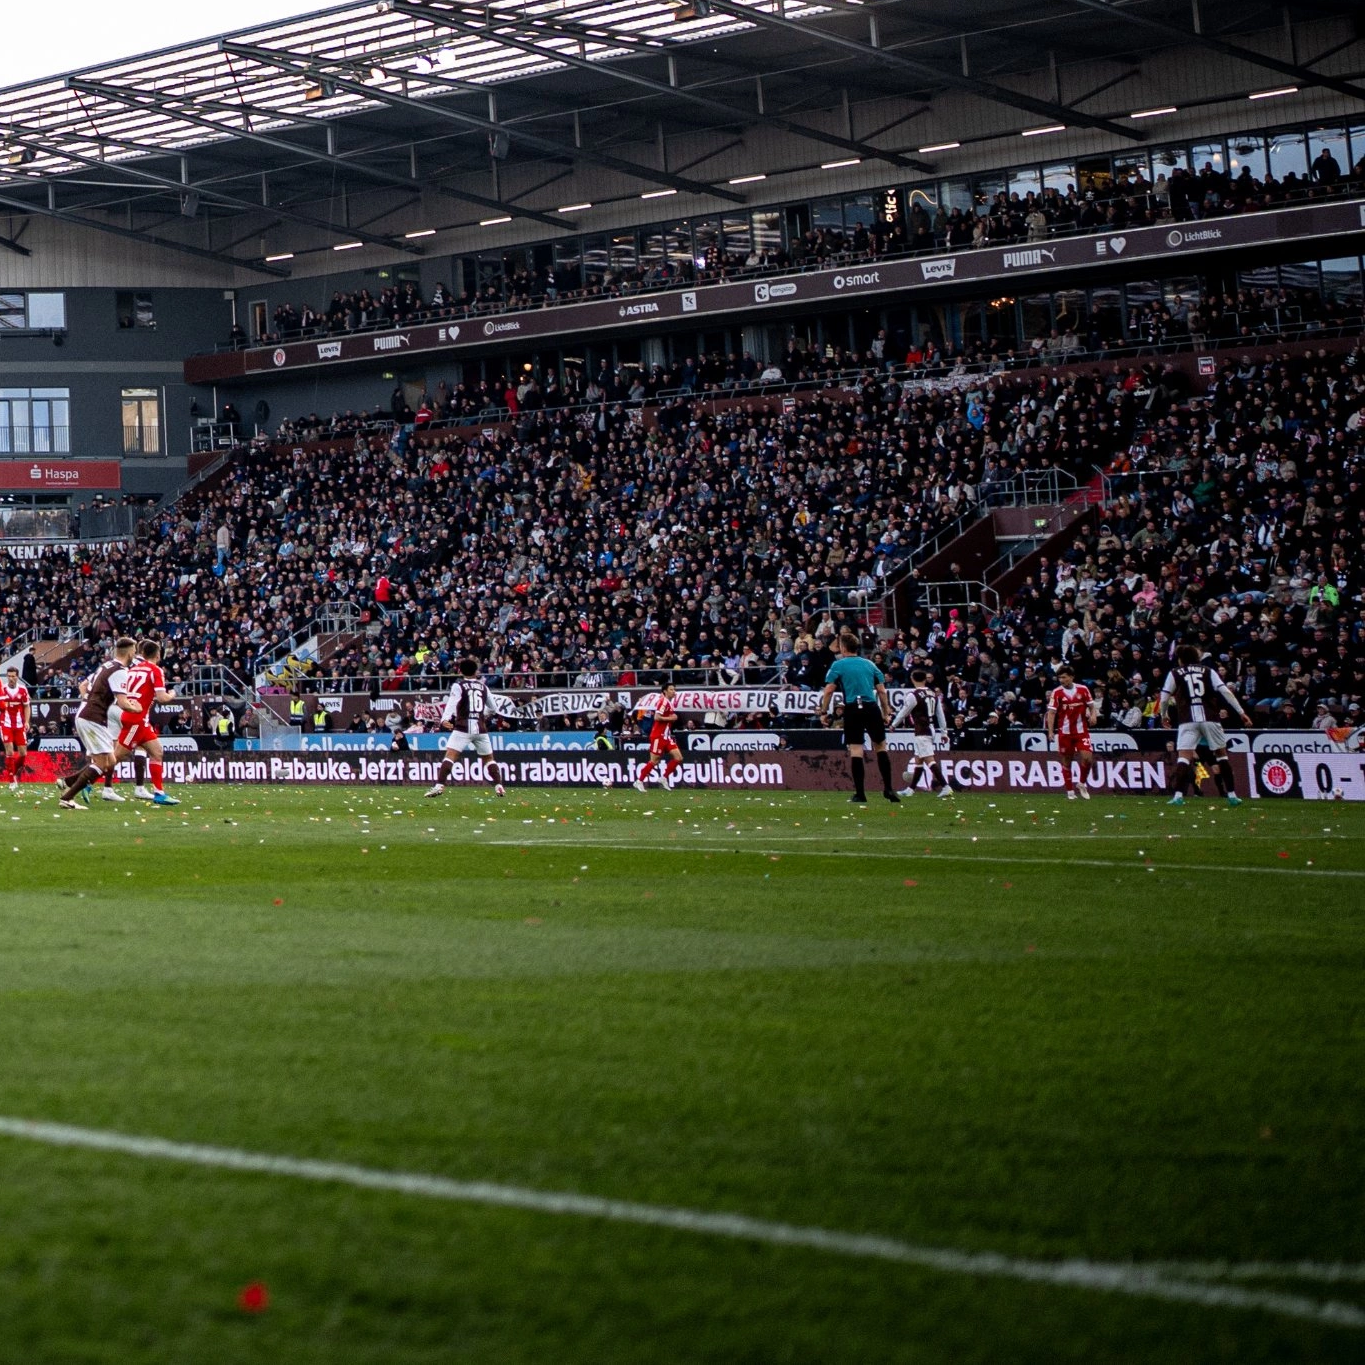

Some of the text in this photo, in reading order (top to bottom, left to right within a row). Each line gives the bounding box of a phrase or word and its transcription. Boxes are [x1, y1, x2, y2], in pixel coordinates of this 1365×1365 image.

[1184, 229, 1222, 242] LichtBlick
[1003, 251, 1041, 268] PUMA
[846, 271, 881, 287] smart
[626, 301, 659, 315] ASTRA
[373, 335, 401, 351] PUMA
[45, 468, 80, 481] Haspa
[1183, 673, 1206, 698] 15
[370, 698, 394, 711] PUMA
[467, 690, 484, 712] 16
[746, 691, 778, 709] FÜR
[925, 696, 936, 717] 10
[160, 704, 184, 713] ASTRA
[301, 736, 420, 751] followfod
[1263, 740, 1333, 753] congsta
[187, 756, 225, 779] wird
[228, 762, 267, 780] man
[270, 758, 356, 781] Rabauke.
[358, 758, 407, 783] Jetzt
[940, 759, 1167, 789] FCSP RABAUKEN
[1315, 762, 1333, 794] 0
